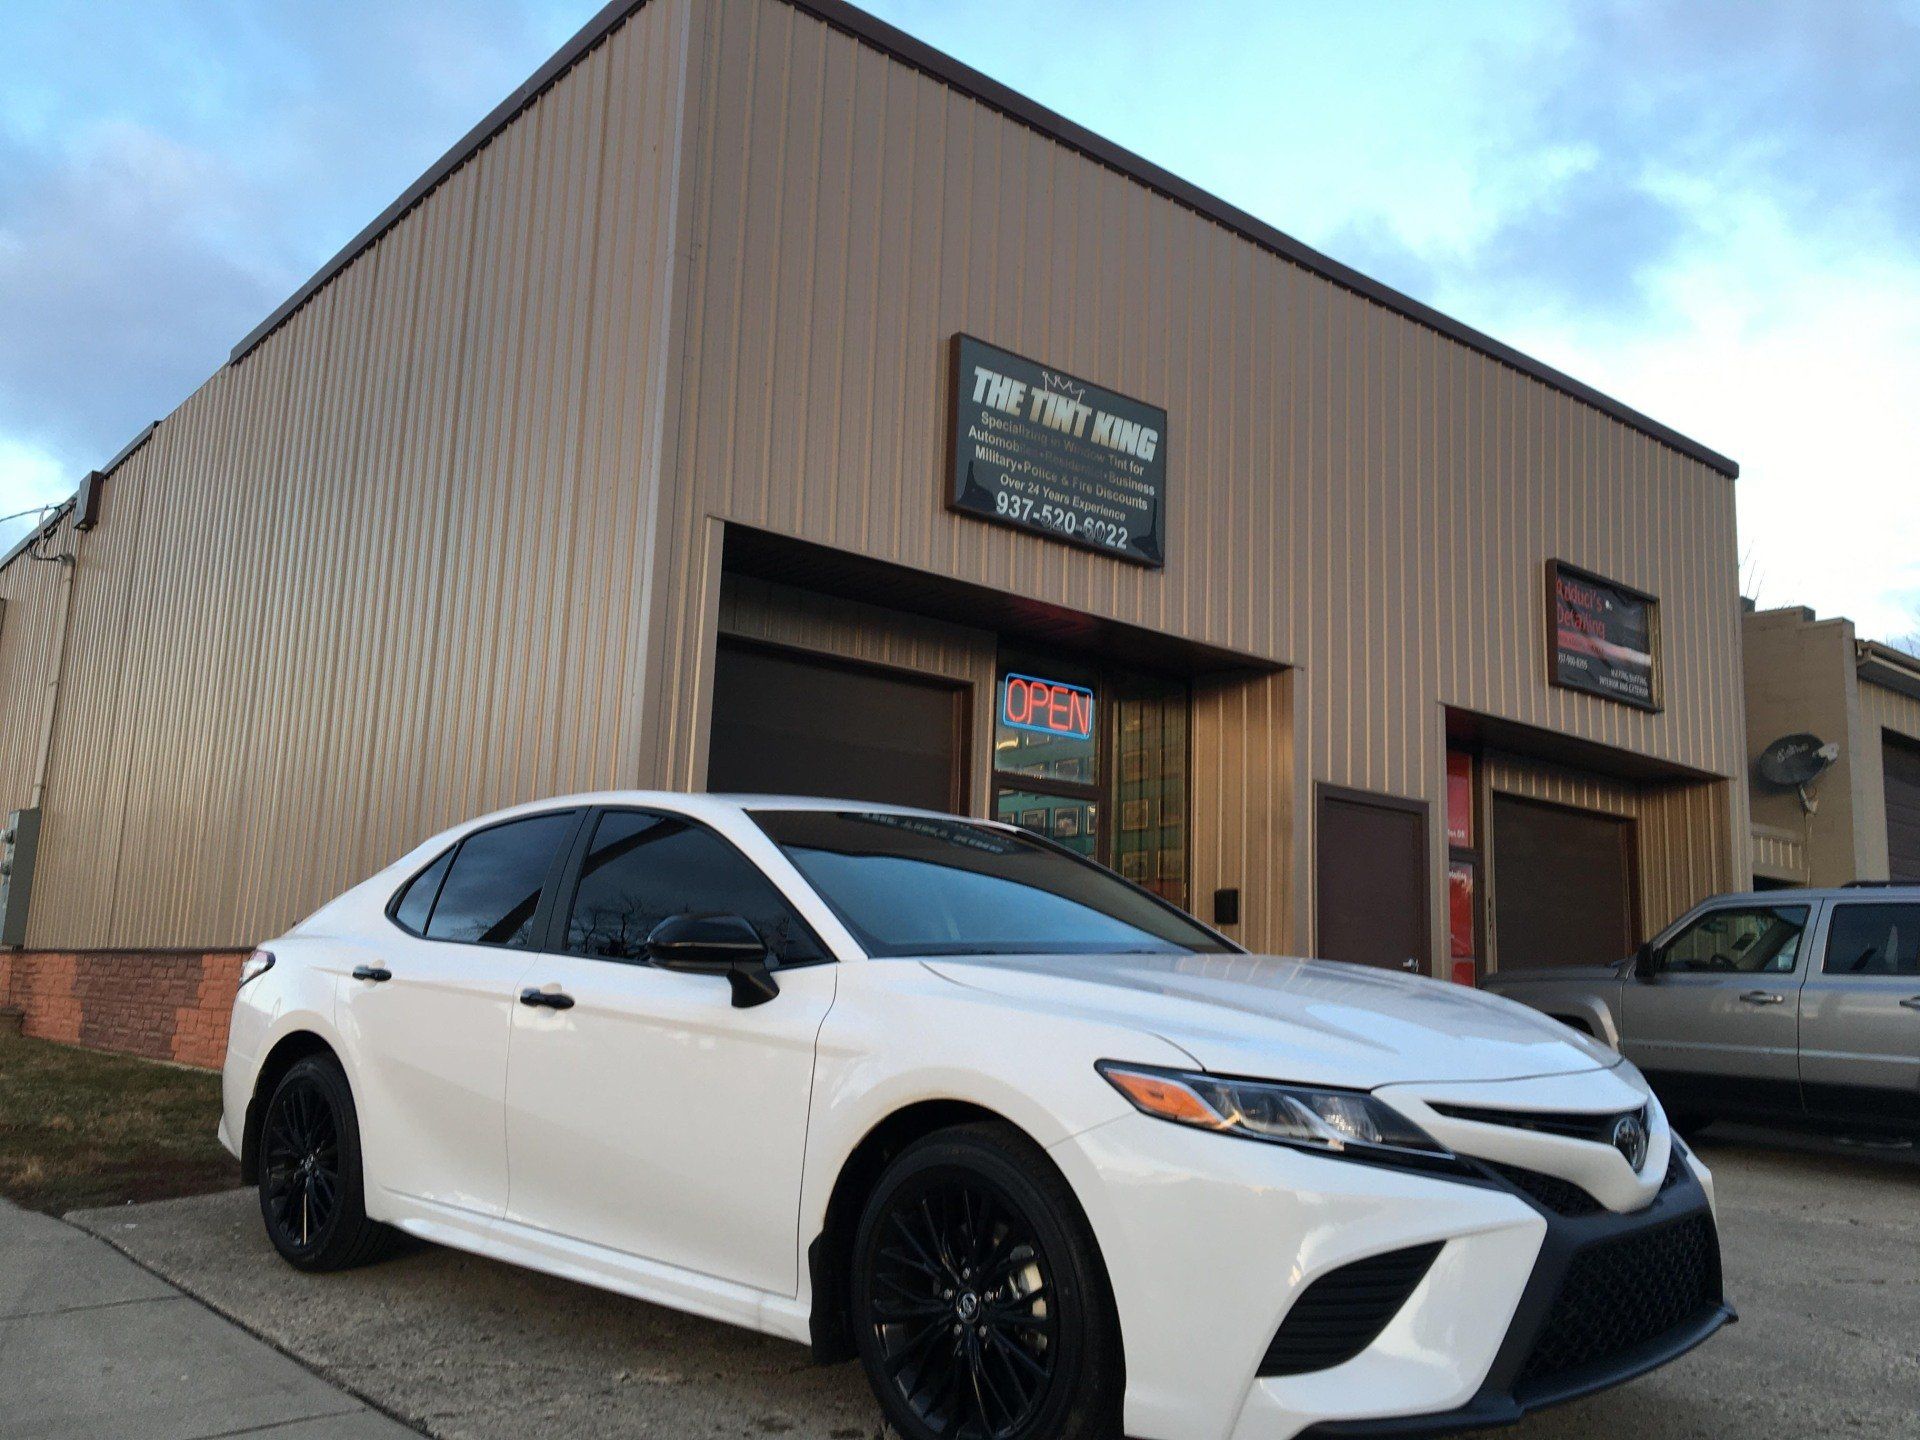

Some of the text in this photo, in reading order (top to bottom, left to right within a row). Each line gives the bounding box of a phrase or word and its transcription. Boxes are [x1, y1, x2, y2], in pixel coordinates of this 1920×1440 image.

[972, 365, 1158, 462] THE TINT KING
[981, 411, 1047, 445] Specializing
[1062, 440, 1104, 463] Window
[1107, 452, 1127, 471] Tint
[1129, 459, 1144, 476] for
[999, 472, 1126, 522] Over 24 Years Experience
[1060, 473, 1068, 487] &
[1071, 476, 1092, 494] Fire
[1095, 482, 1148, 511] Discounts
[996, 491, 1128, 549] 937-520-6022
[1557, 603, 1605, 639] Detailing
[1008, 679, 1090, 733] OPEN
